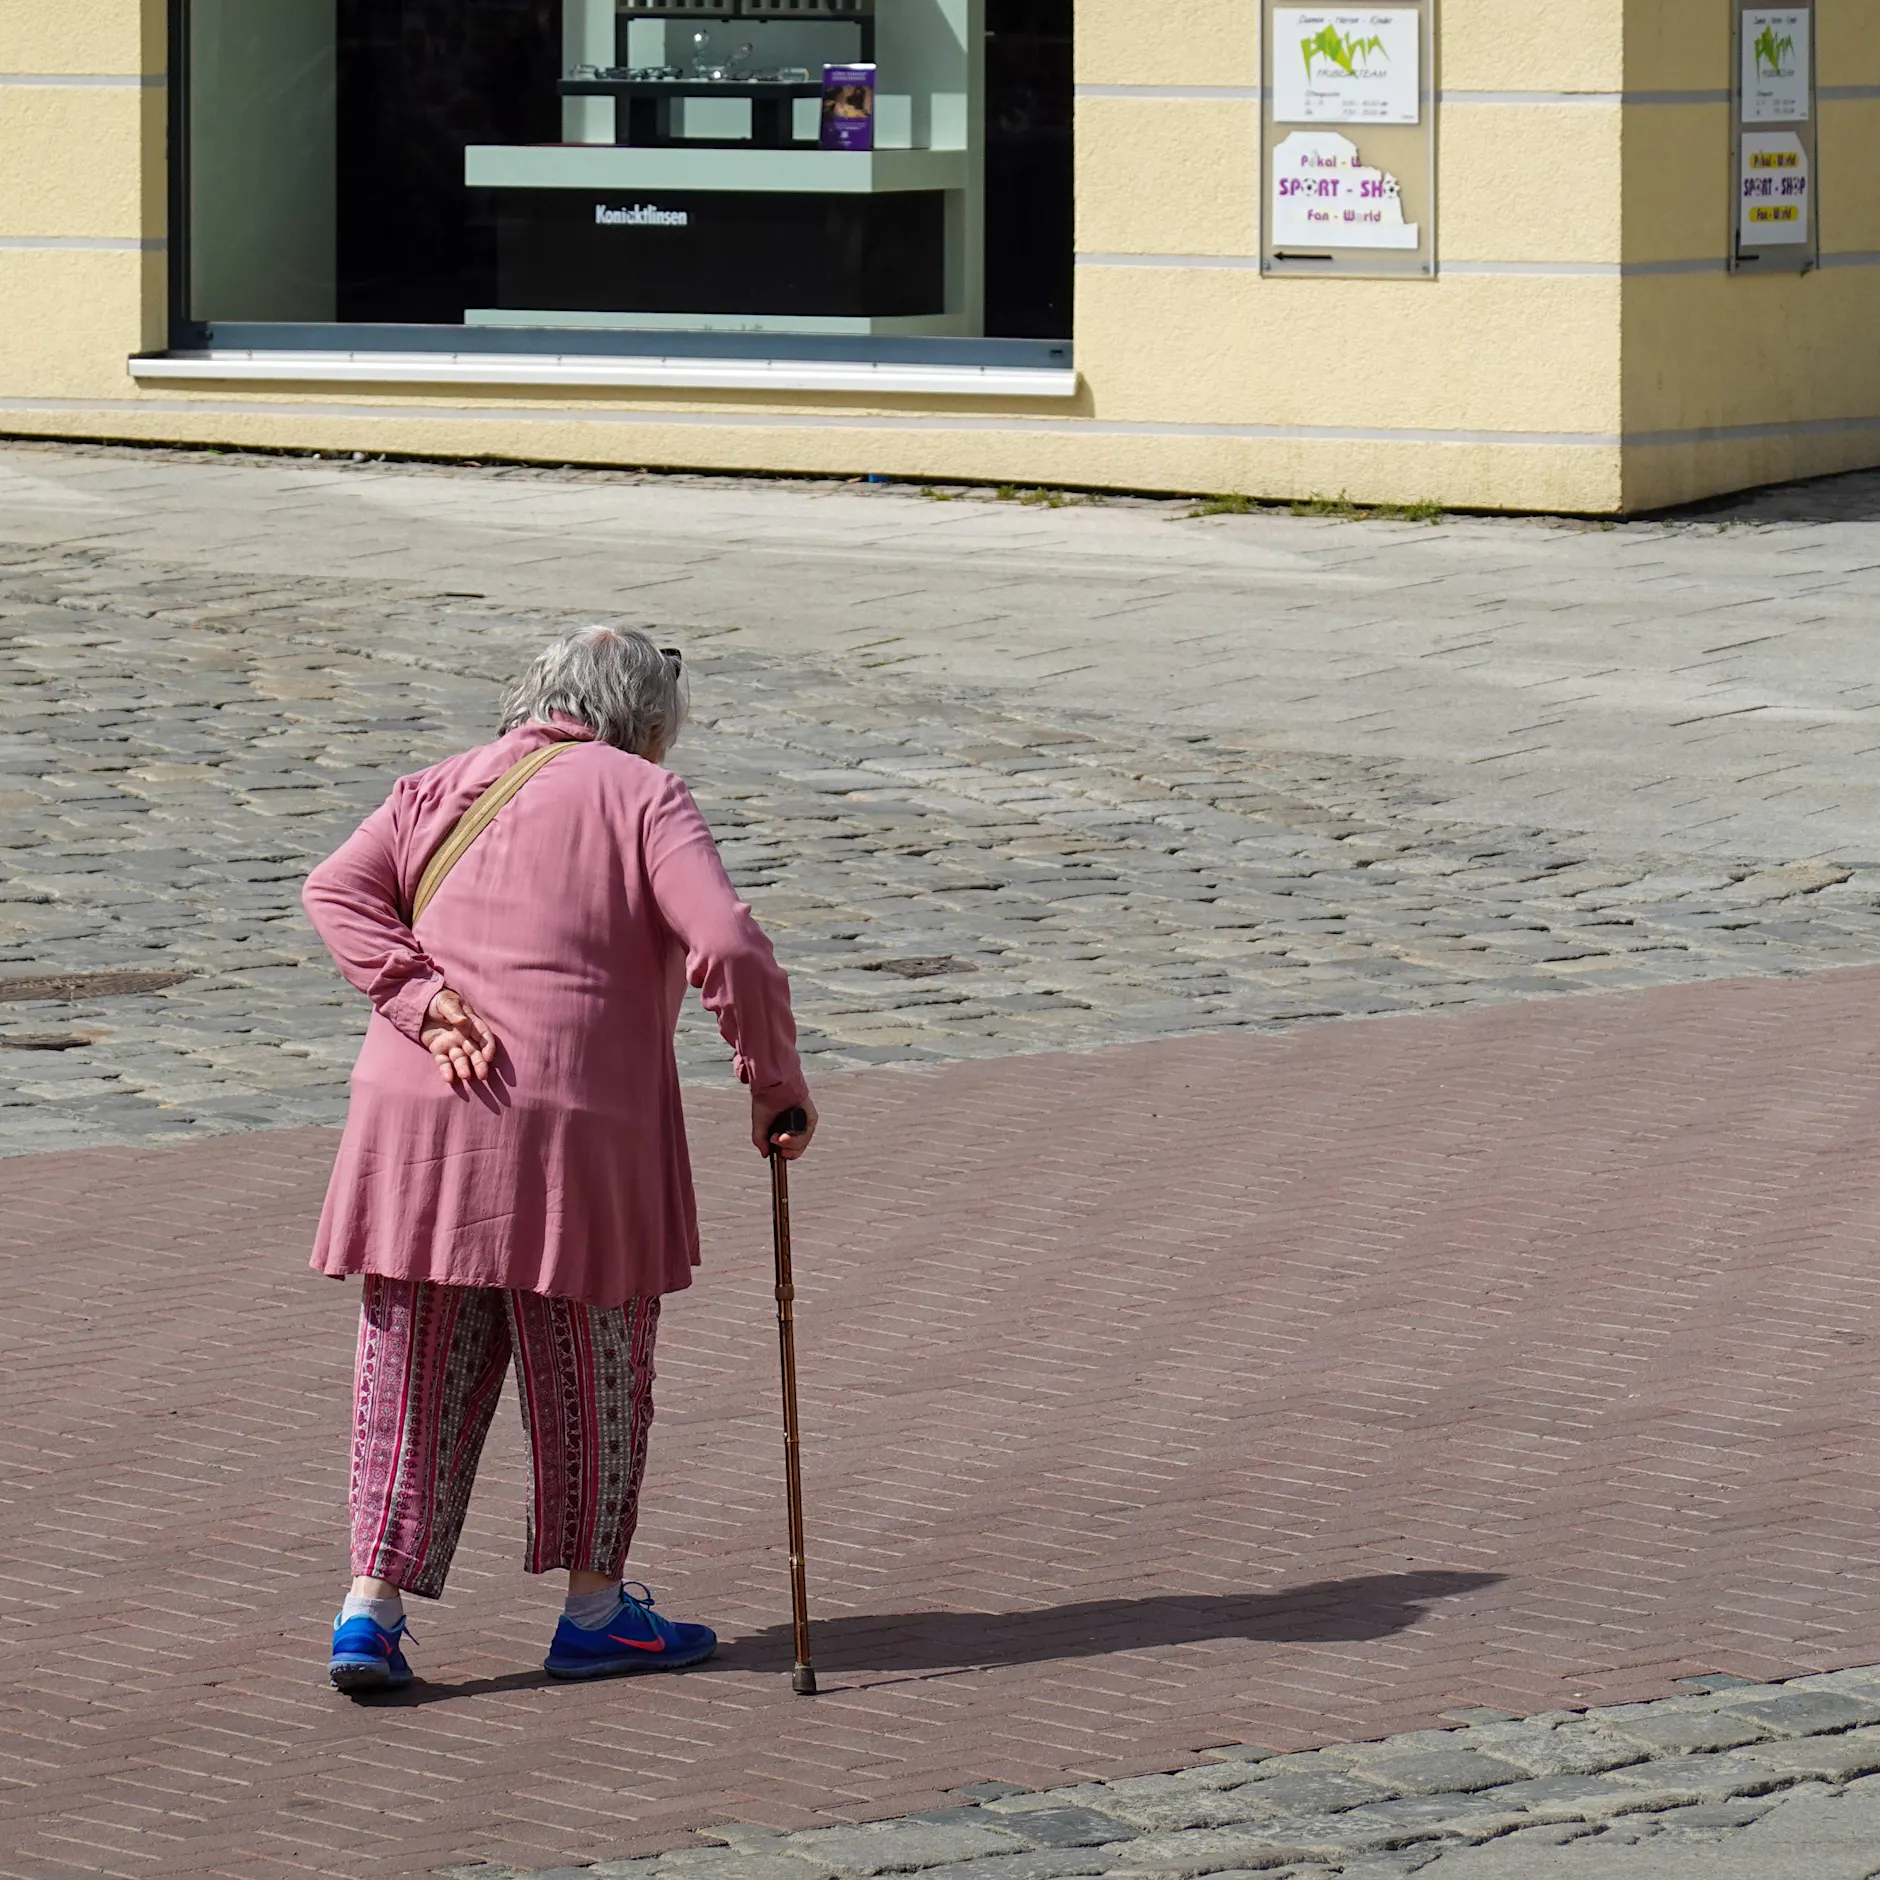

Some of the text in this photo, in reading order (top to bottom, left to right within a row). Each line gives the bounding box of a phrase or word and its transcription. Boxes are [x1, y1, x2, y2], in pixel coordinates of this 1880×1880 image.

[1279, 178, 1340, 197] SPORT
[1744, 177, 1773, 197] SPORT
[1781, 176, 1806, 195] SHOP
[1307, 209, 1329, 221] Fan
[1343, 209, 1381, 222] World
